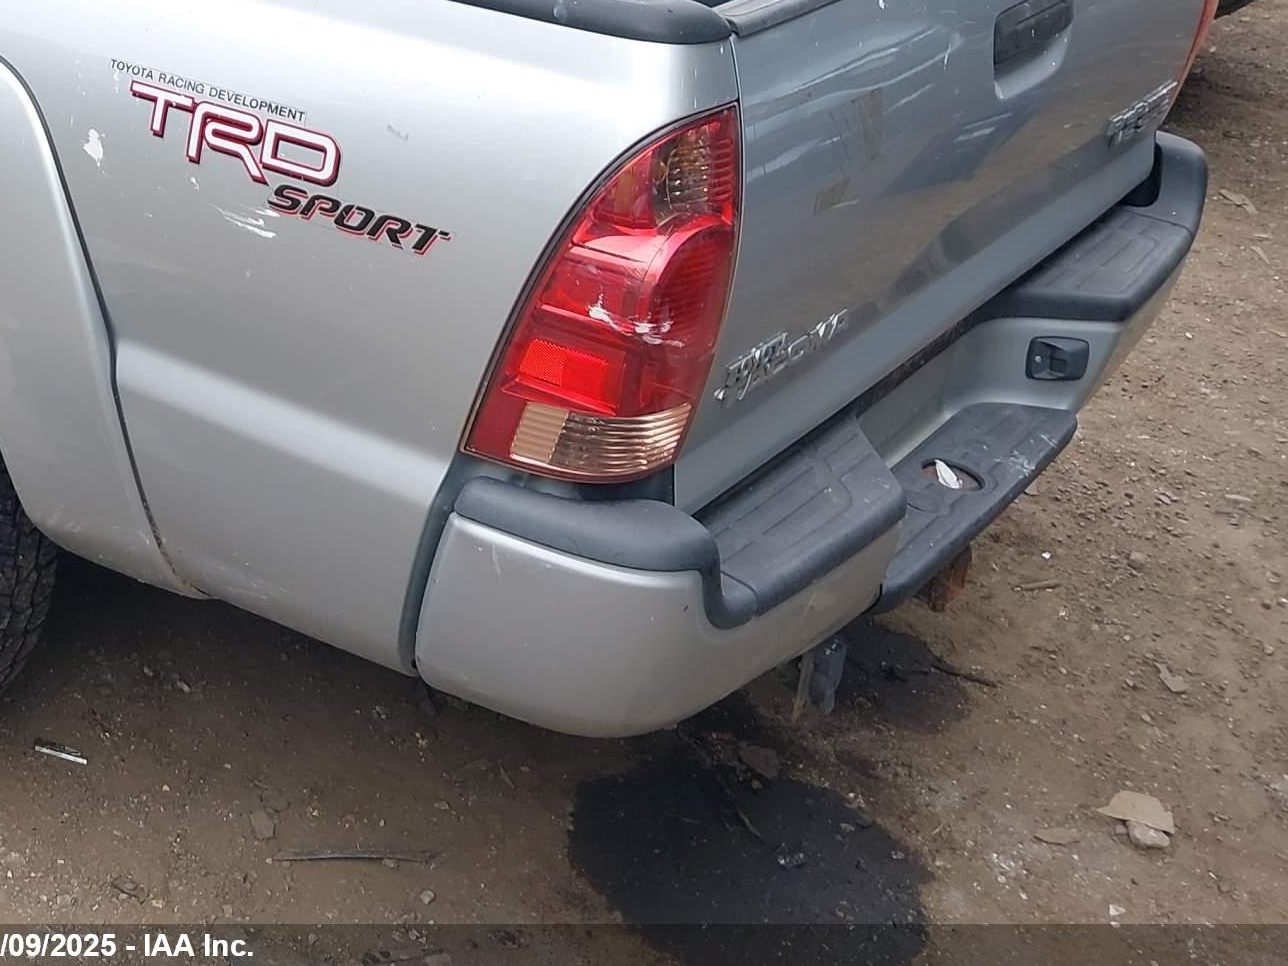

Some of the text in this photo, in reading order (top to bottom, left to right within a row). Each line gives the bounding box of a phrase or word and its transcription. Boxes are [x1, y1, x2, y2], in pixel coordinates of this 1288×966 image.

[110, 58, 306, 123] TOYOTA RACING DEVELOPMENT
[129, 78, 343, 189] TRD
[266, 183, 452, 257] SPORT
